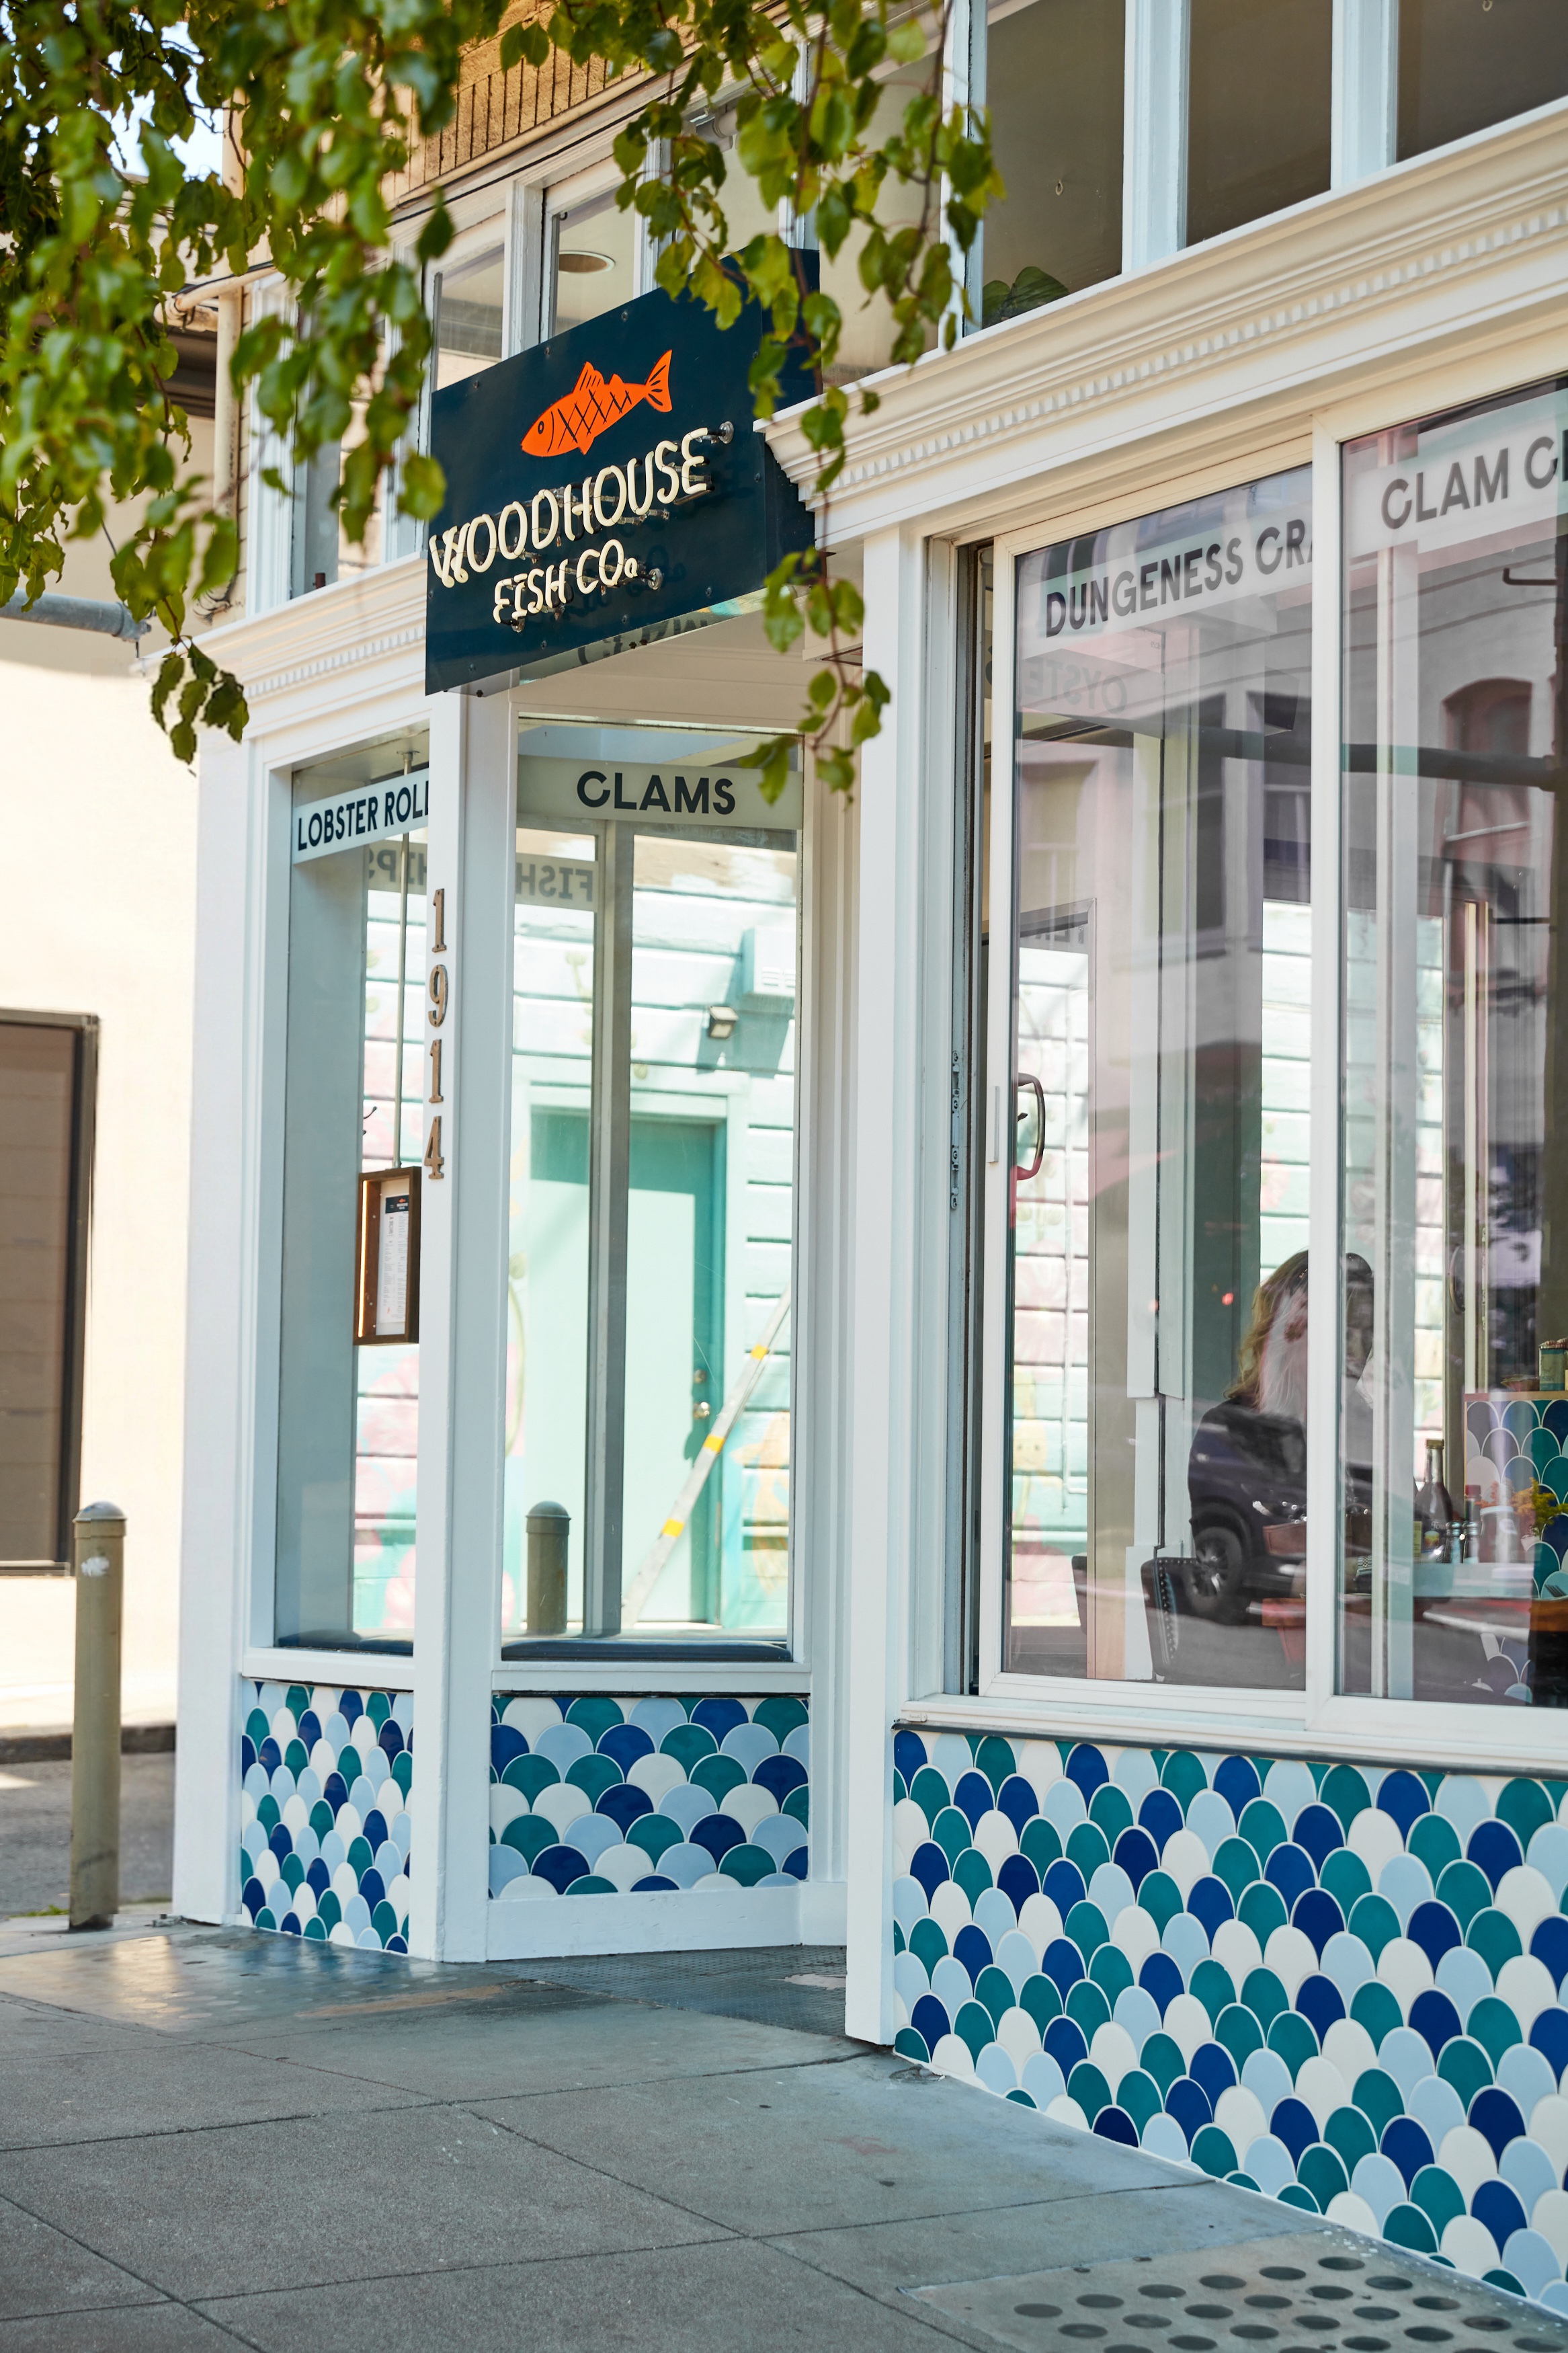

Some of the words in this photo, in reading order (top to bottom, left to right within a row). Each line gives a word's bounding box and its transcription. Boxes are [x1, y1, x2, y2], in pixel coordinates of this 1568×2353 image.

[429, 427, 709, 588] WOODHOUSE
[1381, 447, 1509, 530] CLAM
[1524, 430, 1568, 489] C
[493, 559, 569, 624] FISH
[1046, 537, 1243, 638] DUNGENESS
[1255, 519, 1312, 575] CR
[298, 796, 378, 851] LOBSTER
[576, 770, 736, 815] CLAMS
[424, 888, 449, 1179] 1914
